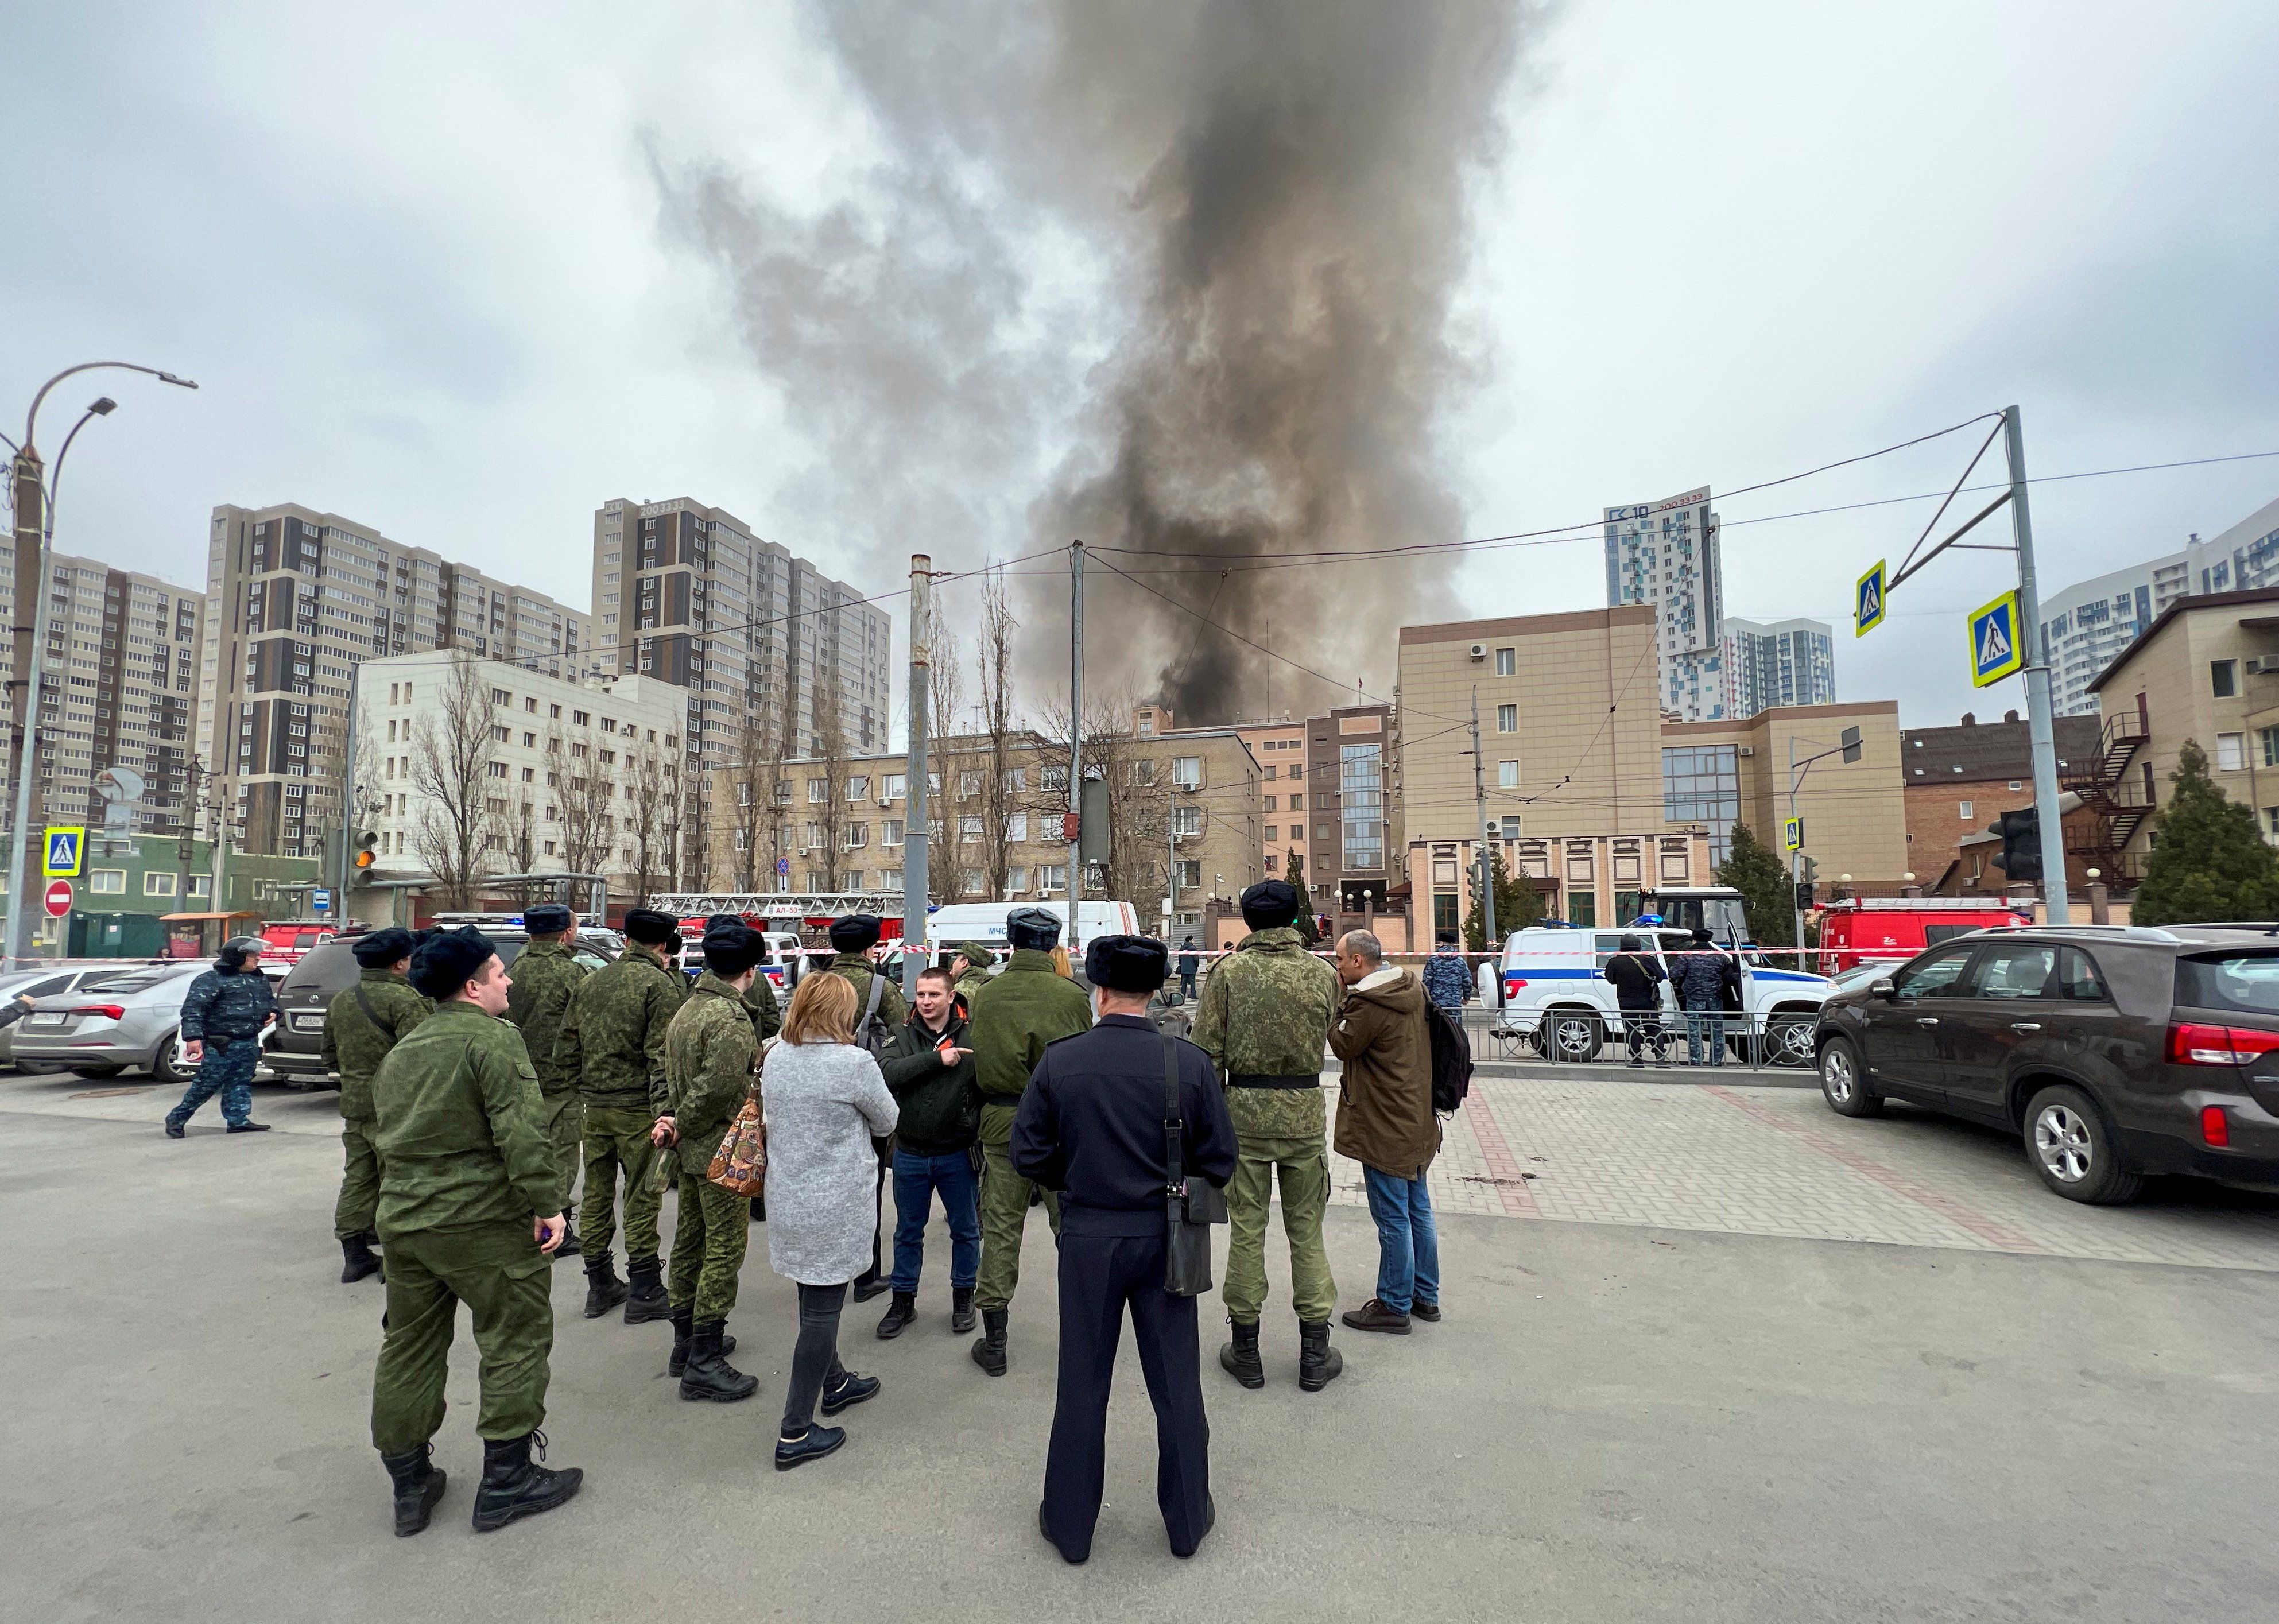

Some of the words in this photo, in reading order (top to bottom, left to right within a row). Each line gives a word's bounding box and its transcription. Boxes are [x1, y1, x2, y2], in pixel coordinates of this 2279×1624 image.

[1679, 497, 1691, 505] 33
[1692, 493, 1703, 502] 33
[1633, 506, 1649, 519] 10
